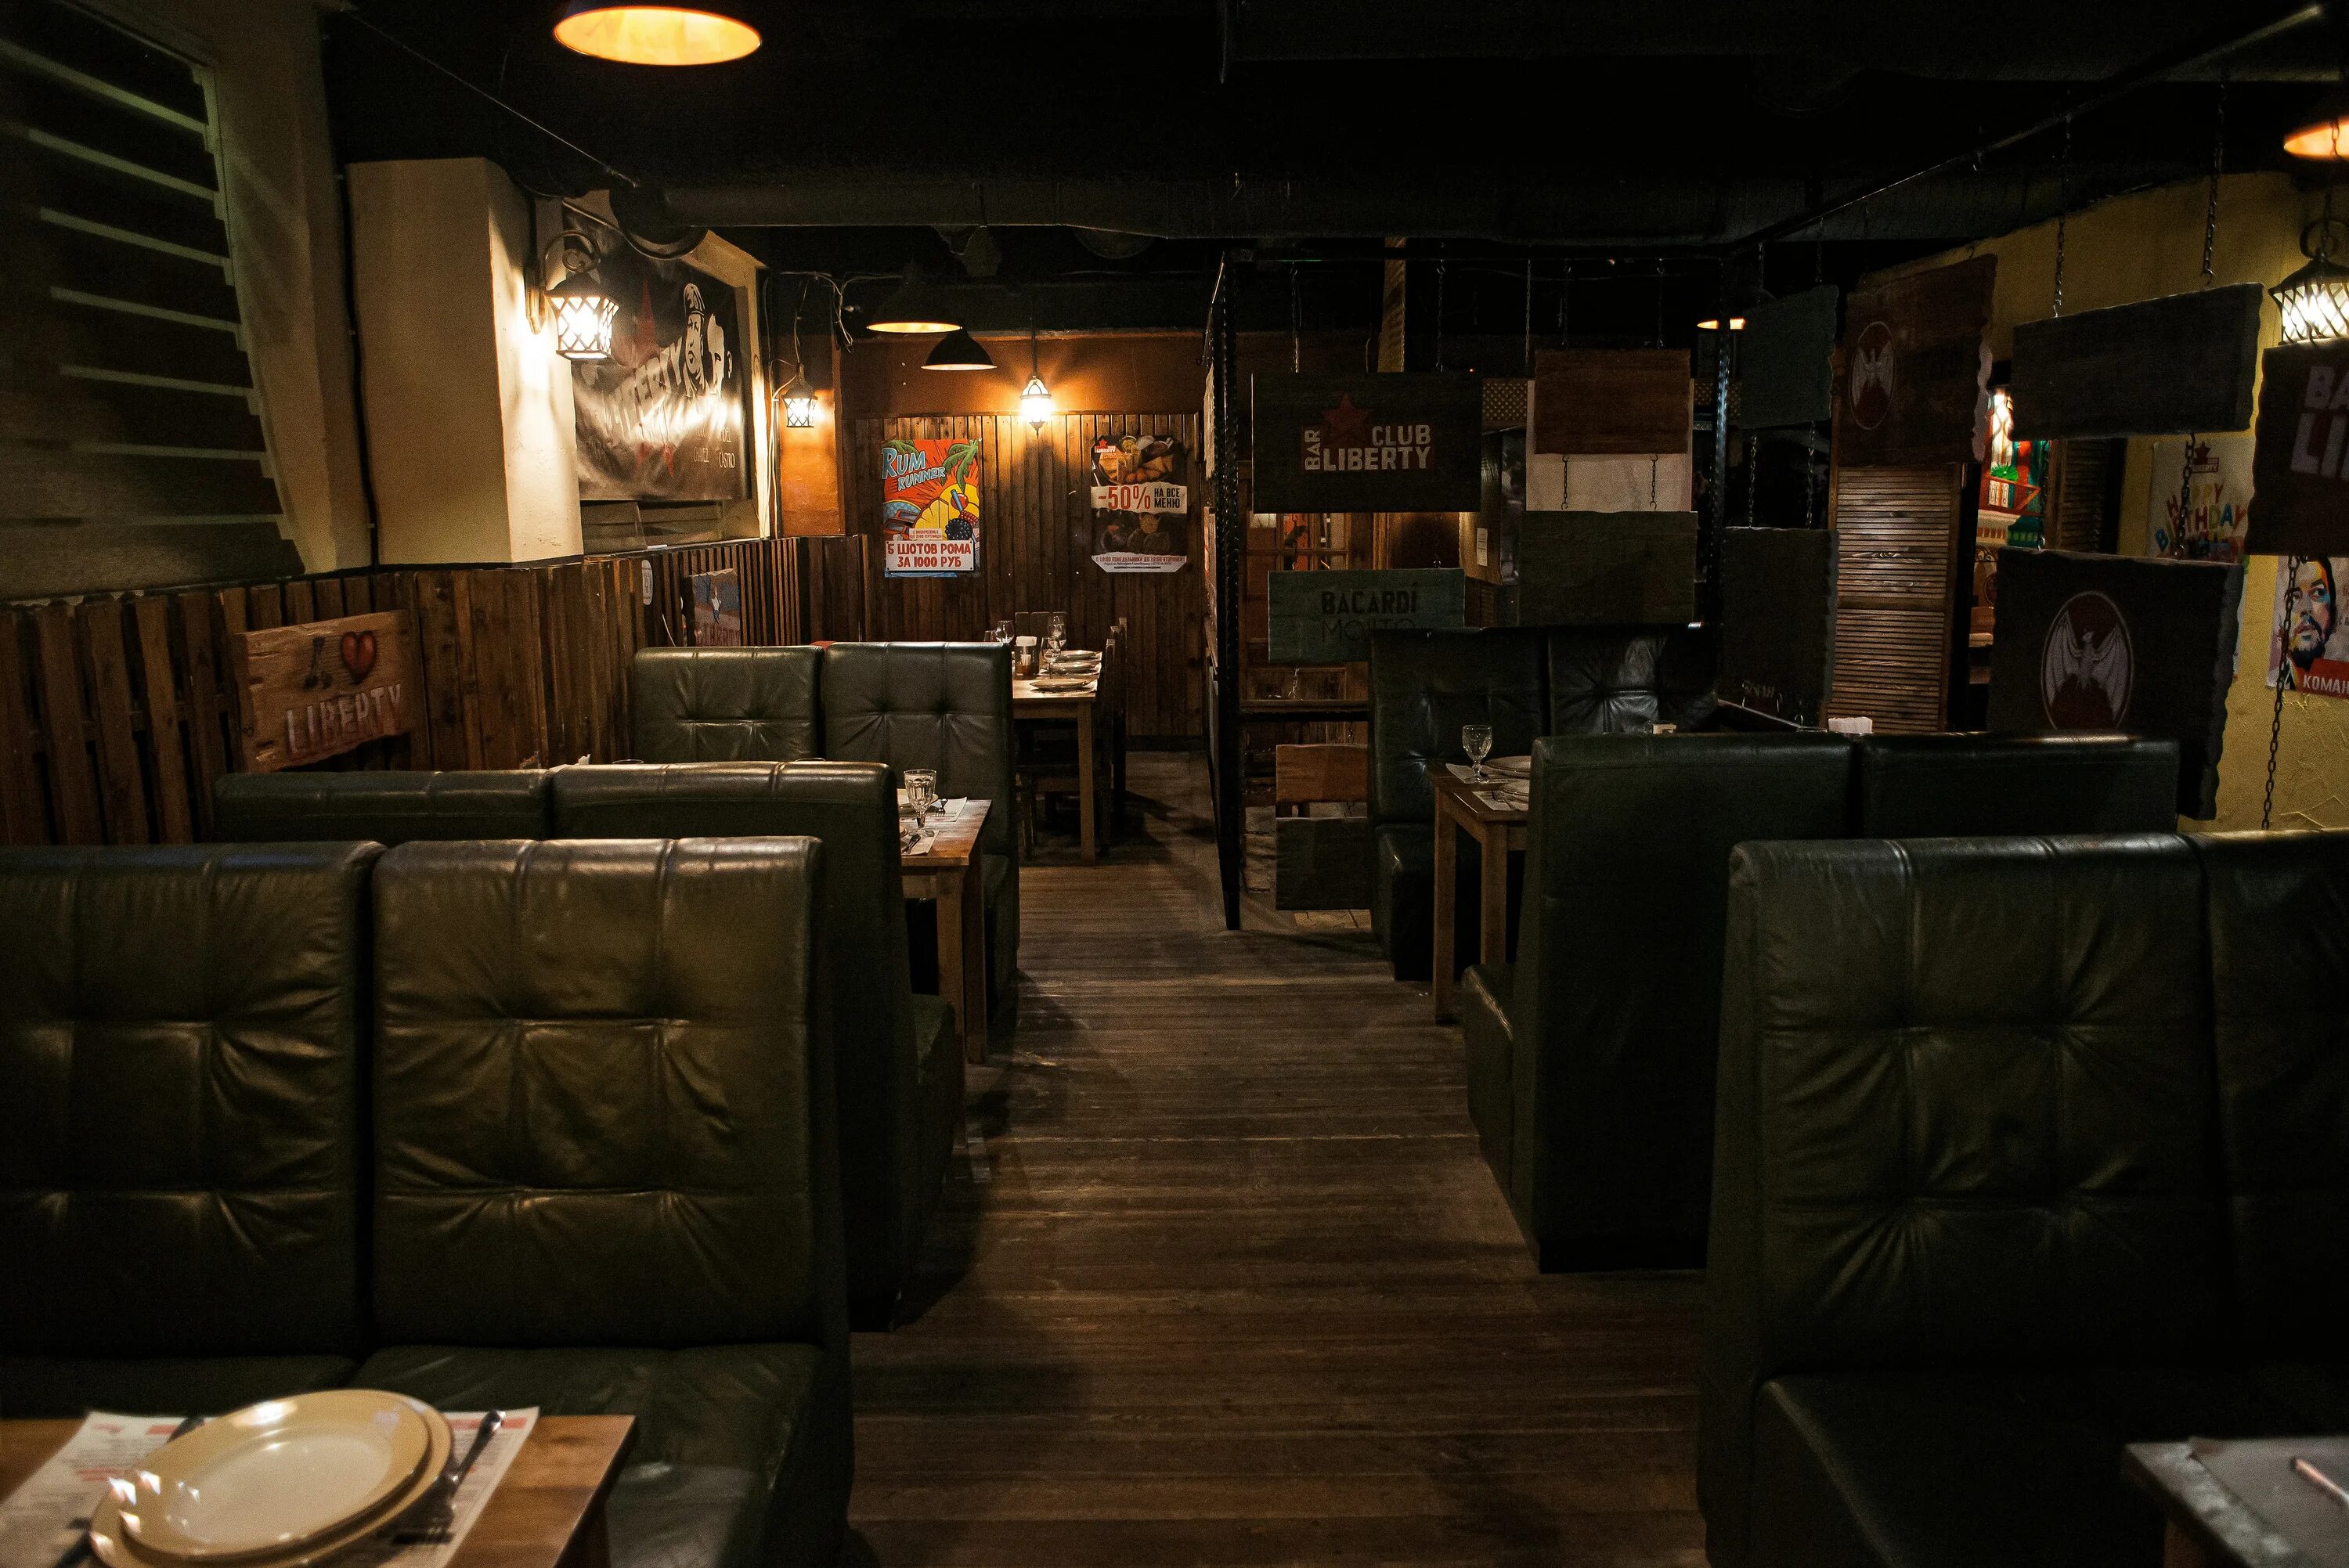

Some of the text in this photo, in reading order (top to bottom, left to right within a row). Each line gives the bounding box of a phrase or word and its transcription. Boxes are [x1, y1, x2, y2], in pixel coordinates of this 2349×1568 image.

[1372, 424, 1431, 446] CLUB
[1304, 429, 1320, 470] BAR
[1323, 446, 1431, 470] LIBERTY
[882, 447, 926, 479] RUM
[898, 467, 946, 492] RUNNER
[1098, 485, 1151, 510] -50%
[1154, 488, 1180, 498] НА ВСЕ
[1154, 498, 1180, 509] МЕНЮ
[887, 543, 971, 555] 5 ШОТОВ РОМА
[897, 557, 962, 568] ЗА 1000 РУБ
[2304, 674, 2349, 695] КОМАН
[285, 683, 401, 760] LIBERTY
